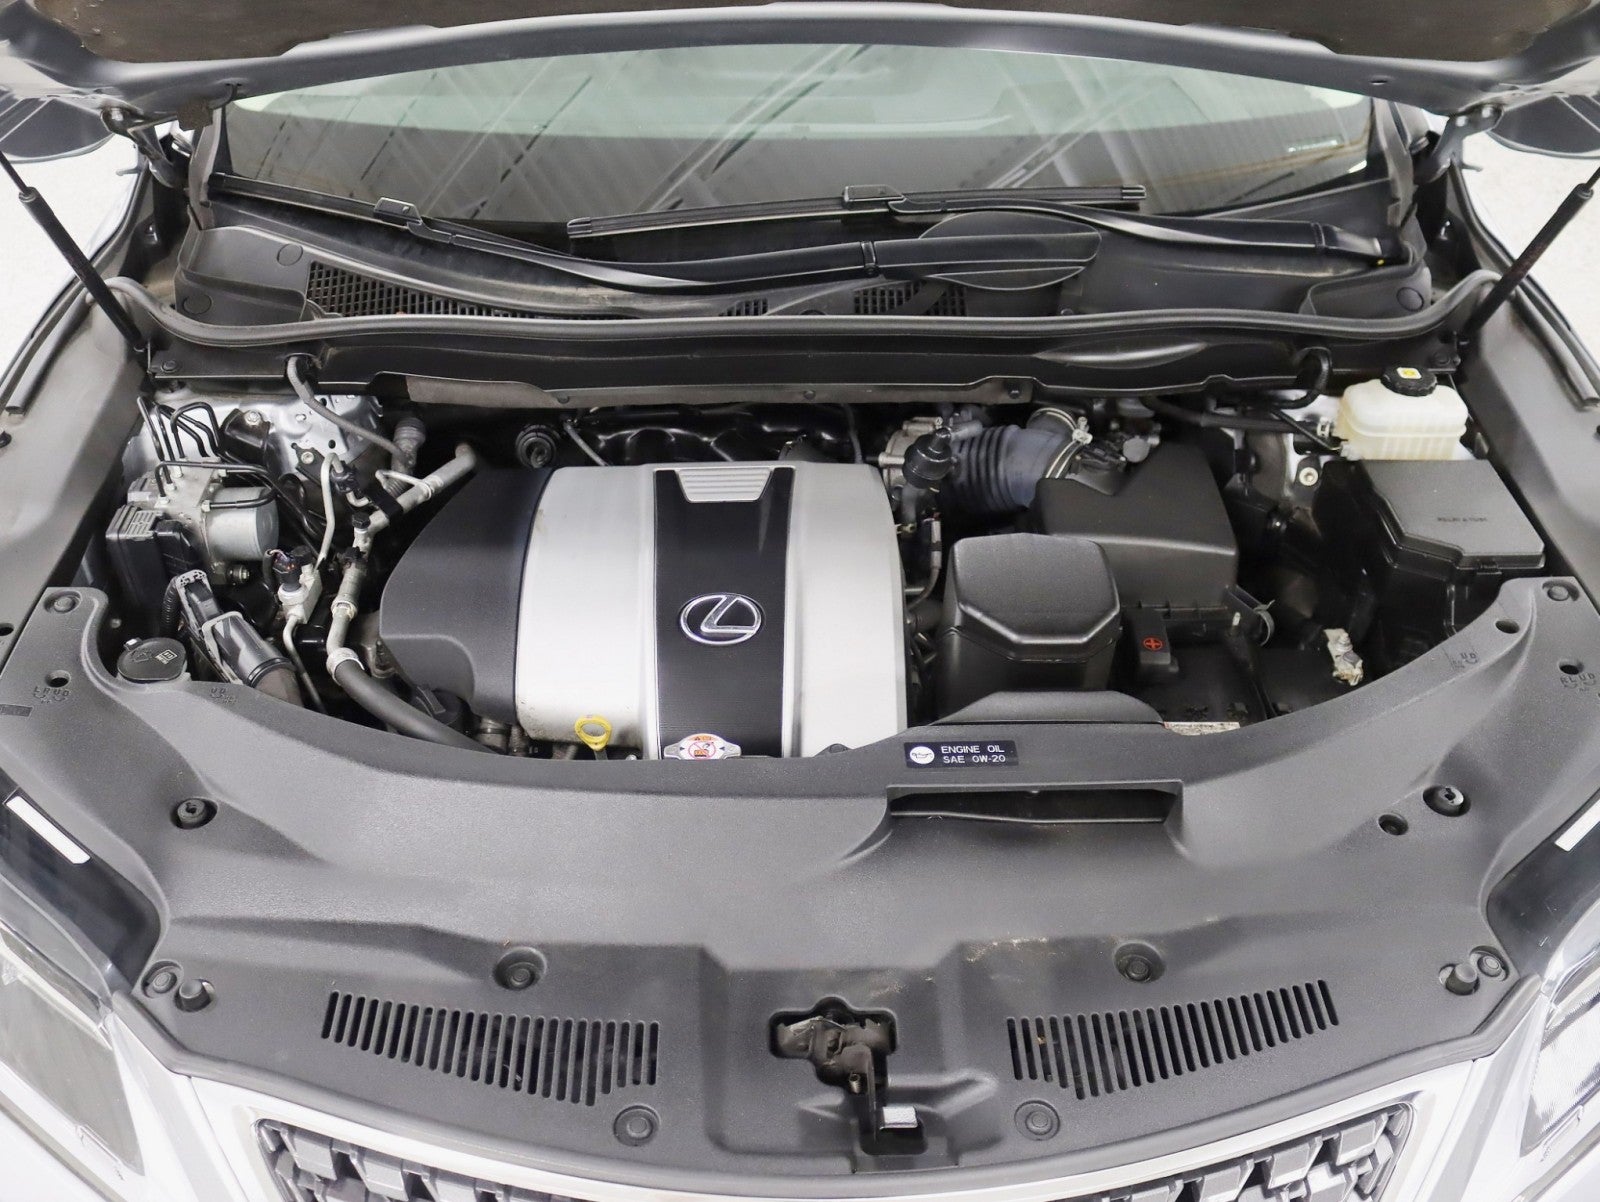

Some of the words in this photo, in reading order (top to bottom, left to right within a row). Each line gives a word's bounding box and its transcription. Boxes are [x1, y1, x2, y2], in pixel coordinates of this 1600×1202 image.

[941, 745, 981, 754] ENGINE
[987, 744, 1005, 753] OIL
[943, 755, 966, 764] SAE
[971, 754, 1006, 763] 0W-20
